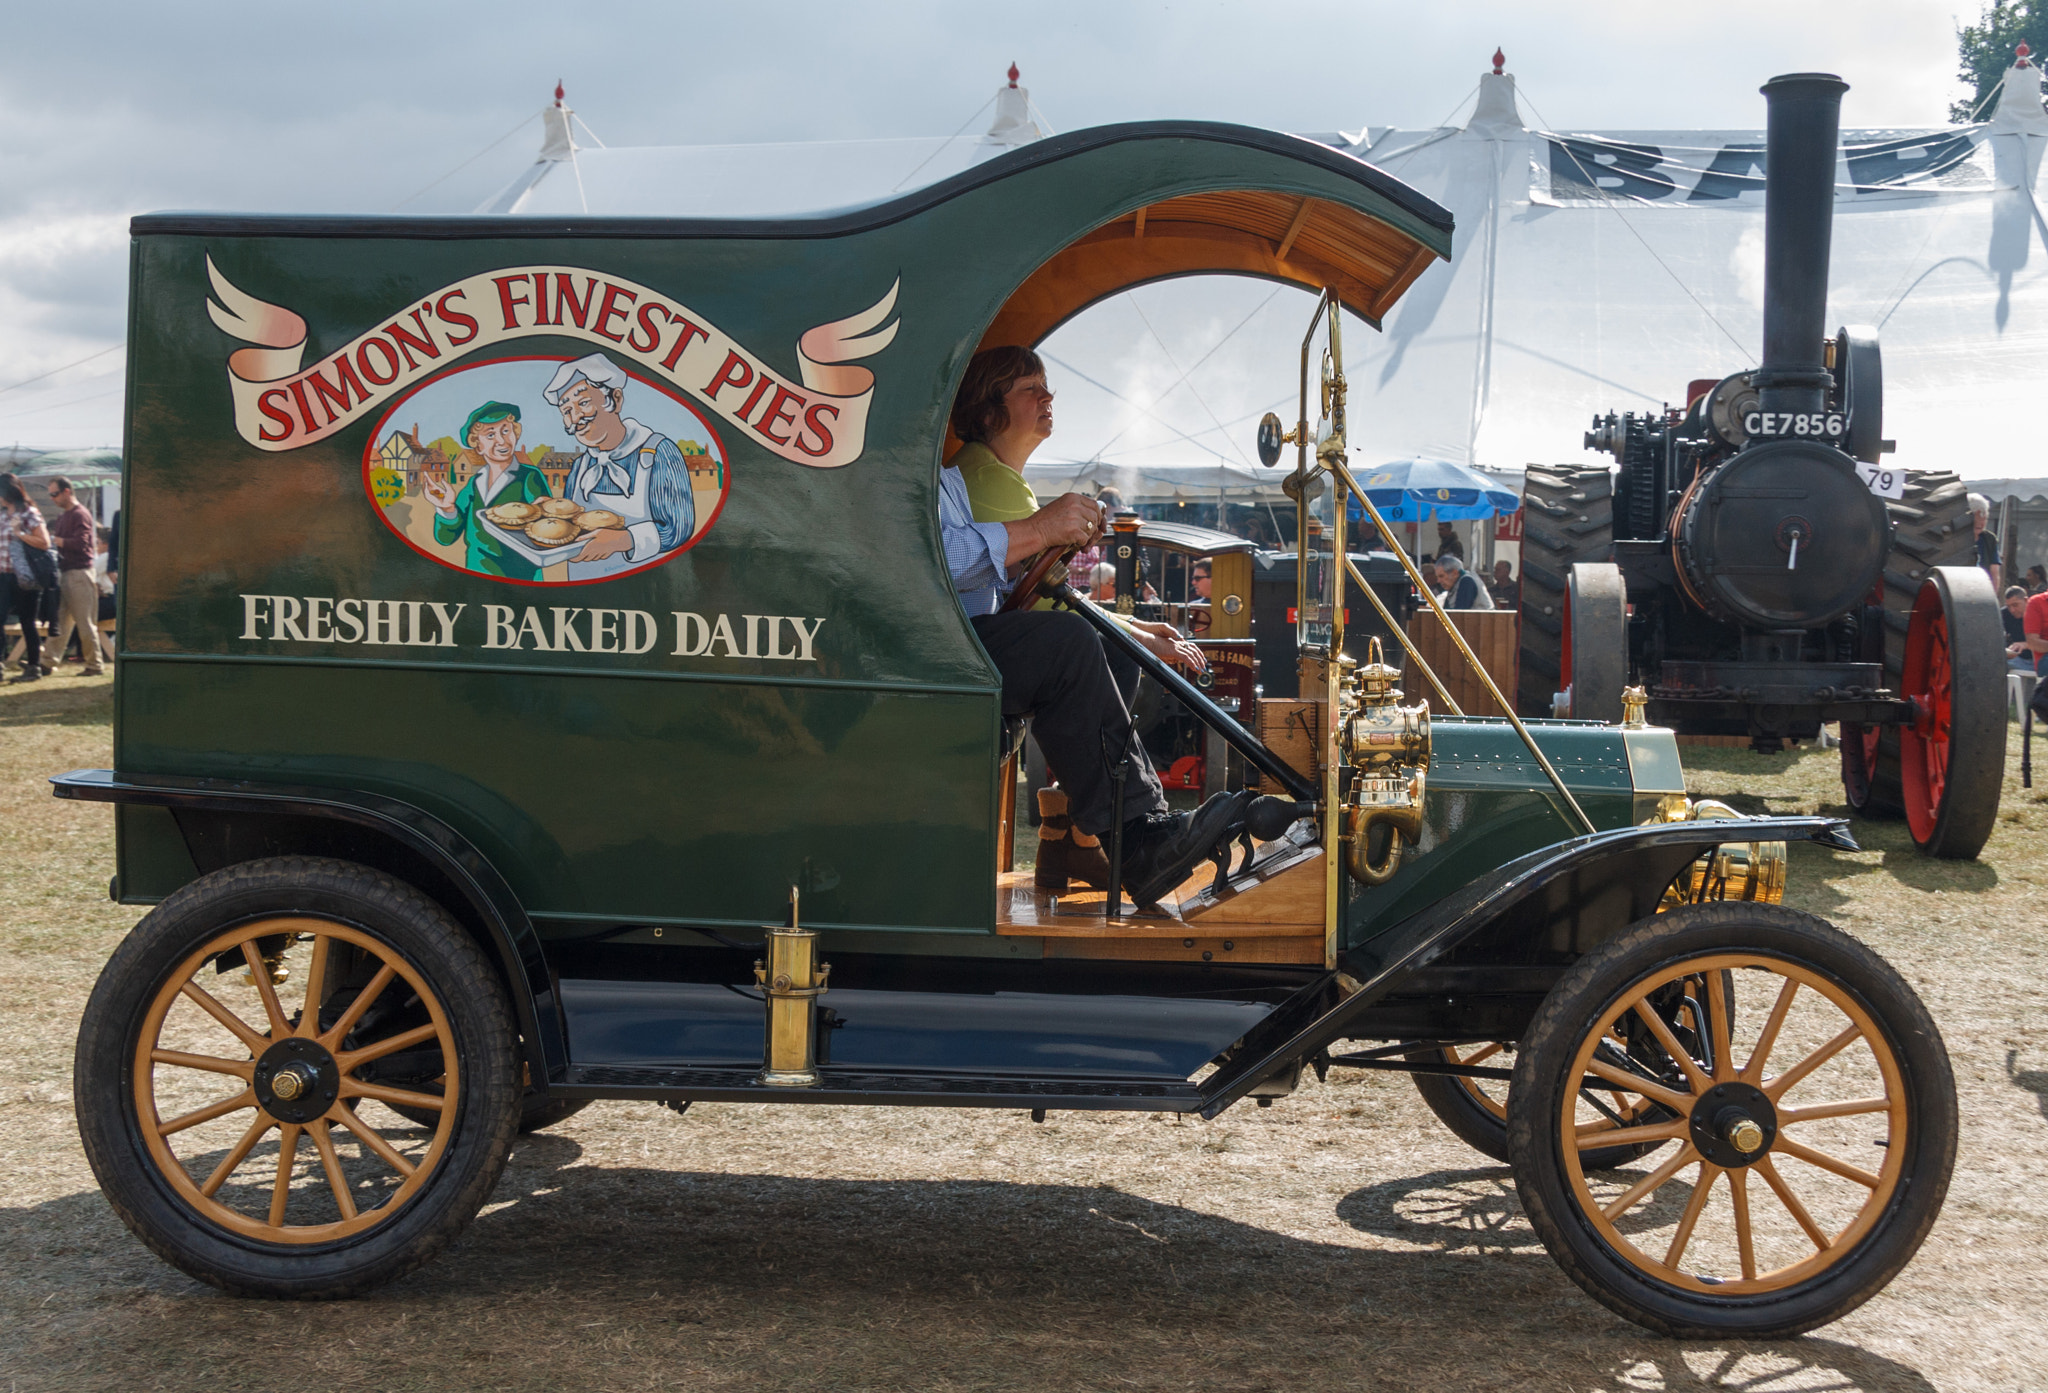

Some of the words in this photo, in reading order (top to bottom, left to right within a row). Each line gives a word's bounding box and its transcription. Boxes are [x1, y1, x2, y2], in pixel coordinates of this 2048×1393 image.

[257, 289, 479, 441] SIMON'S
[491, 272, 710, 372] FINEST
[700, 348, 840, 457] PIES
[1744, 412, 1843, 436] CE7856
[1867, 468, 1893, 491] 79
[239, 594, 467, 647] FRESHLY
[481, 604, 657, 654] BAKED
[670, 611, 826, 661] DAILY
